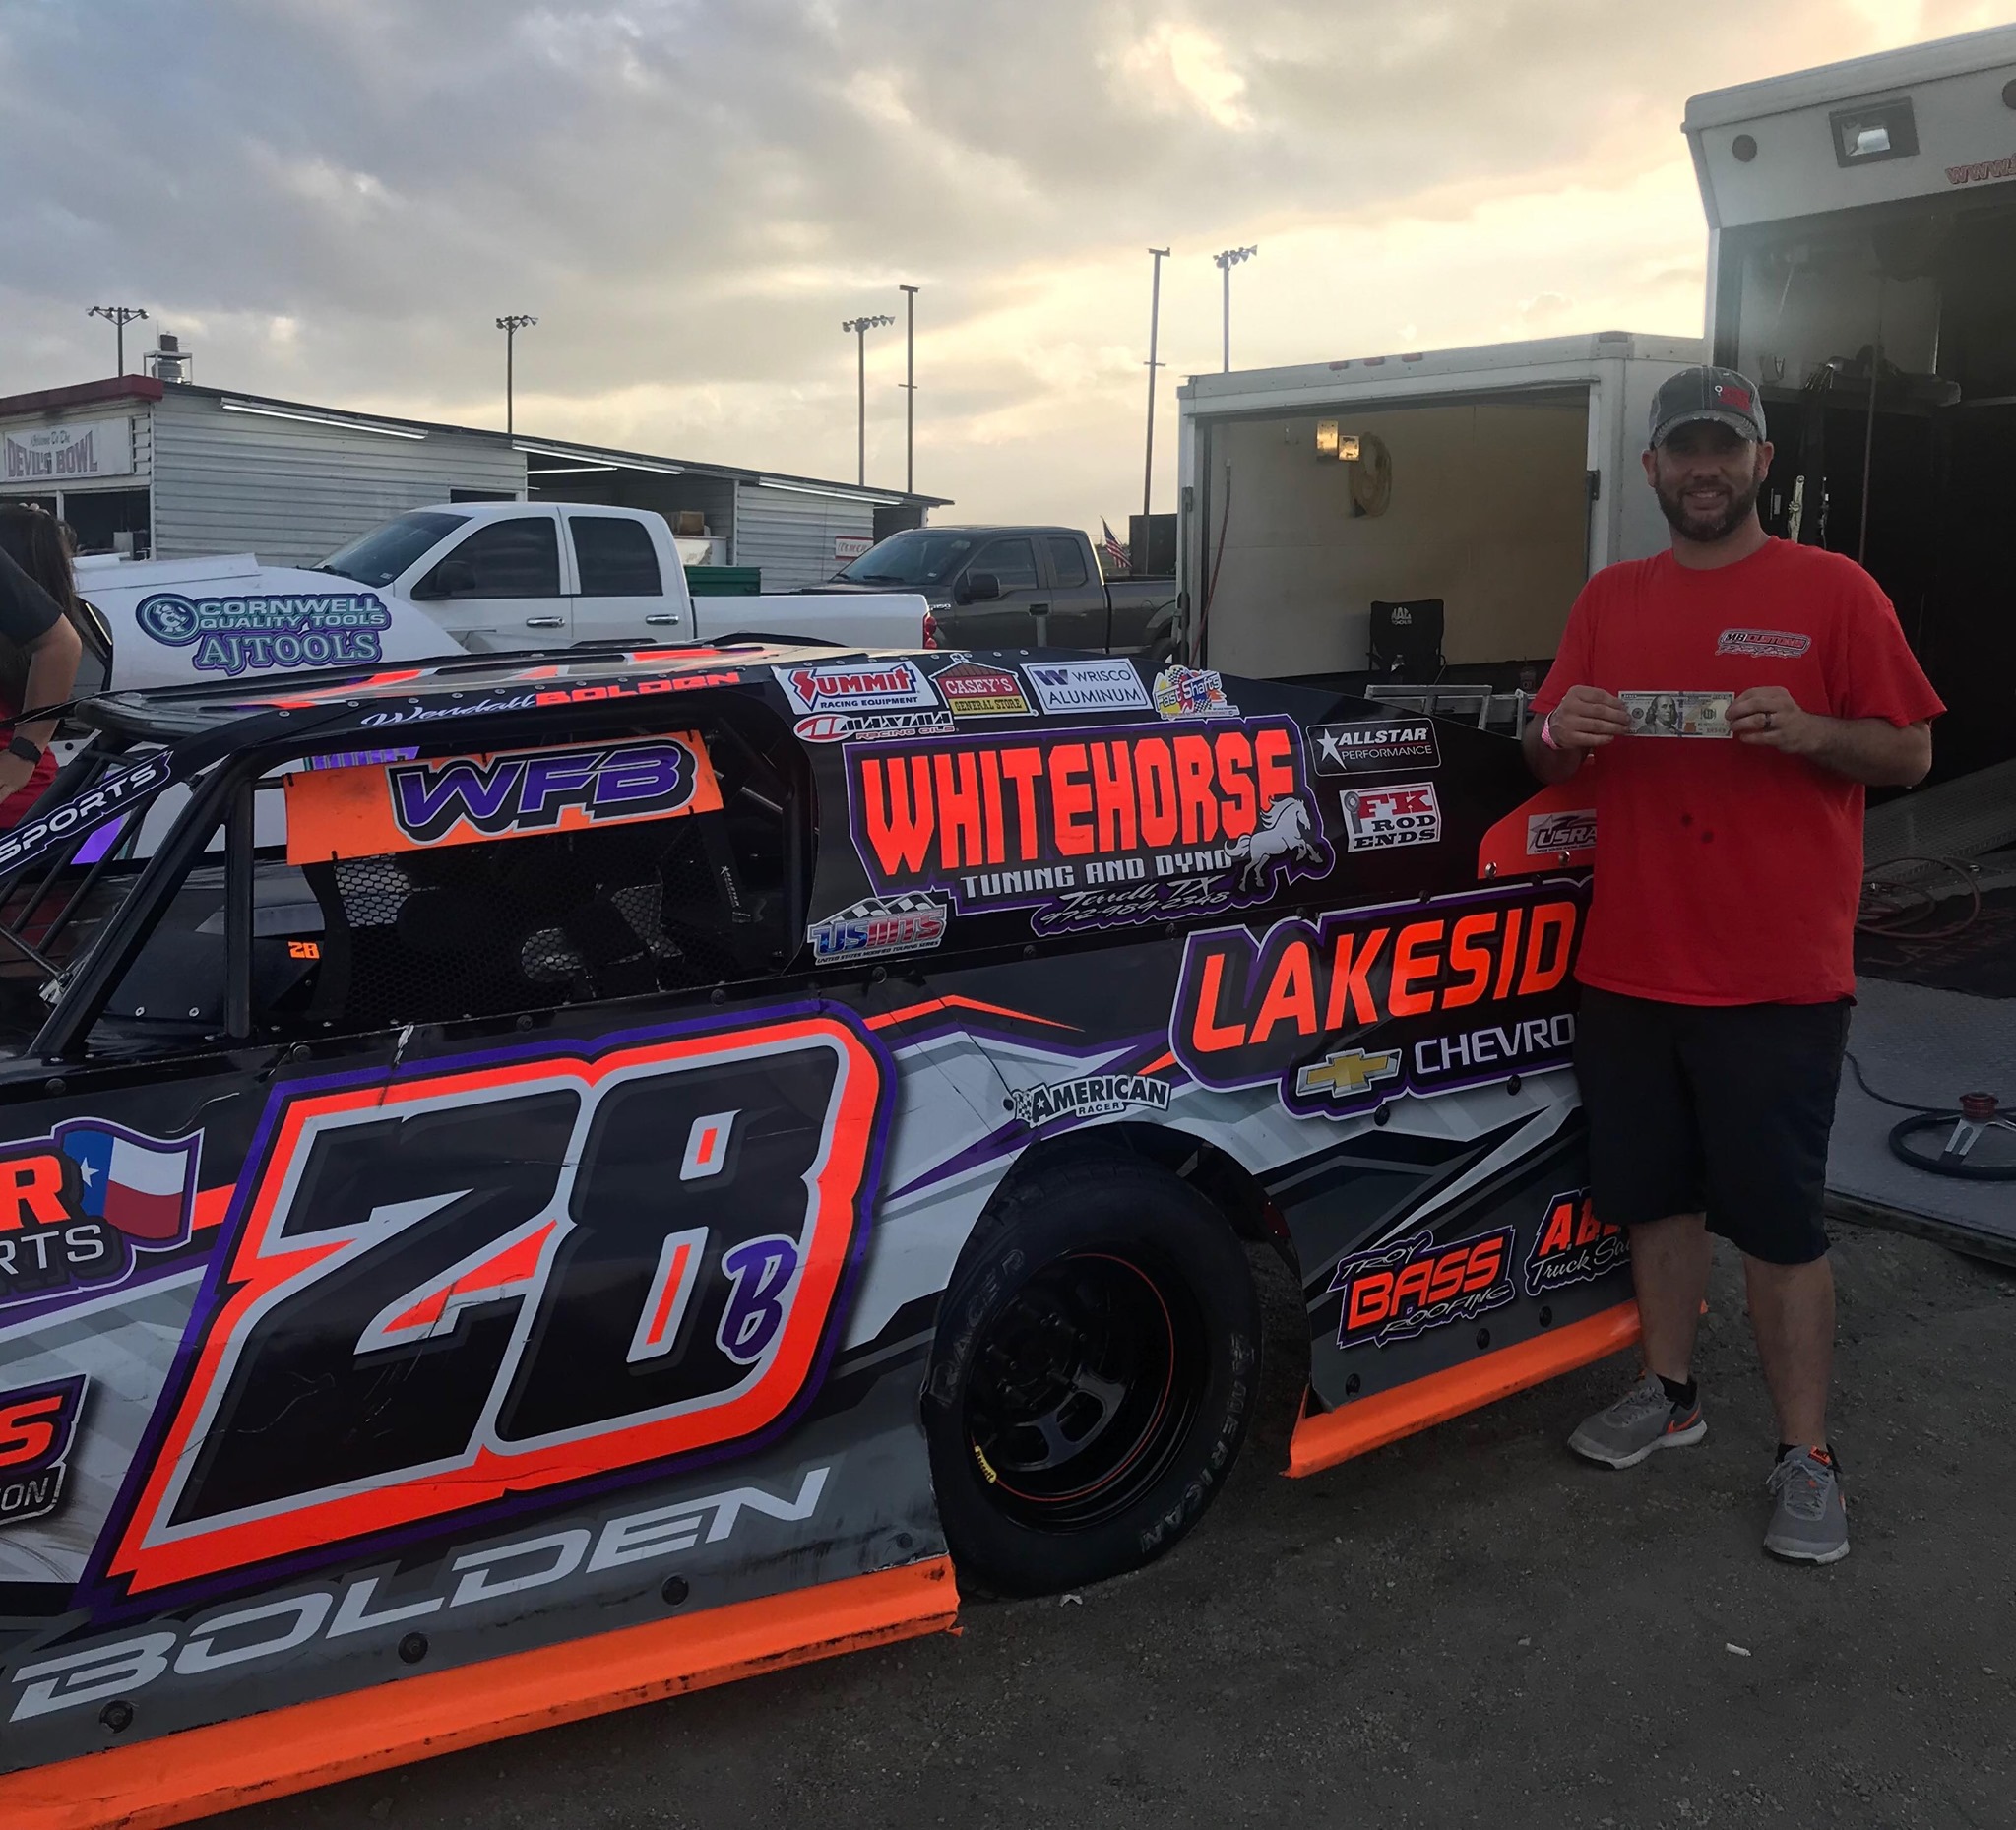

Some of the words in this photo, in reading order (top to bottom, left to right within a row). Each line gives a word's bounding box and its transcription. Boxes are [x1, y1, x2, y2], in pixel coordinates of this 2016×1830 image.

[7, 438, 52, 477] DEVIL'S
[56, 430, 97, 473] BOWL
[199, 598, 381, 616] CORNWELL
[201, 615, 302, 629] QUALITY
[312, 614, 386, 627] TOOLS
[946, 676, 1014, 695] CASEY'S
[1071, 669, 1131, 683] WRISCO
[1156, 687, 1182, 710] Fast
[1182, 675, 1222, 700] Shafts
[361, 693, 538, 727] Wendall
[820, 699, 858, 709] RACING
[861, 696, 918, 707] EQUIPMENT
[955, 698, 995, 711] GENERAL
[997, 697, 1022, 710] STORE
[1049, 688, 1142, 705] ALUMINUM
[839, 711, 954, 732] MAXIMA
[855, 728, 915, 740] RACING
[918, 725, 956, 735] OILS
[1339, 727, 1427, 746] ALLSTAR
[1341, 744, 1433, 761] PERFORMANCE
[395, 744, 682, 829] WFB
[861, 729, 1294, 875] WHITEHORSE
[0, 764, 157, 862] SPORTS
[1358, 789, 1433, 819] FK
[1354, 828, 1436, 850] ENDS
[1372, 815, 1436, 833] ROD
[960, 865, 1075, 899] TUNING
[1086, 858, 1145, 884] AND
[1155, 850, 1232, 877] DYNO
[1166, 874, 1225, 900] TX
[812, 909, 944, 954] USMTS
[287, 941, 320, 959] 28
[1192, 901, 1576, 1053] LAKESID
[1416, 1014, 1575, 1075] CHEVRO
[1033, 1077, 1167, 1123] AMERICAN
[1078, 1102, 1120, 1115] RACER
[1343, 1238, 1423, 1279] TROY
[1530, 1250, 1592, 1284] Truck
[724, 1240, 795, 1360] B
[1348, 1236, 1503, 1330] BASS
[116, 1022, 873, 1585] 28
[1379, 1284, 1511, 1336] ROOFING
[9, 1467, 830, 1723] BOLDEN
